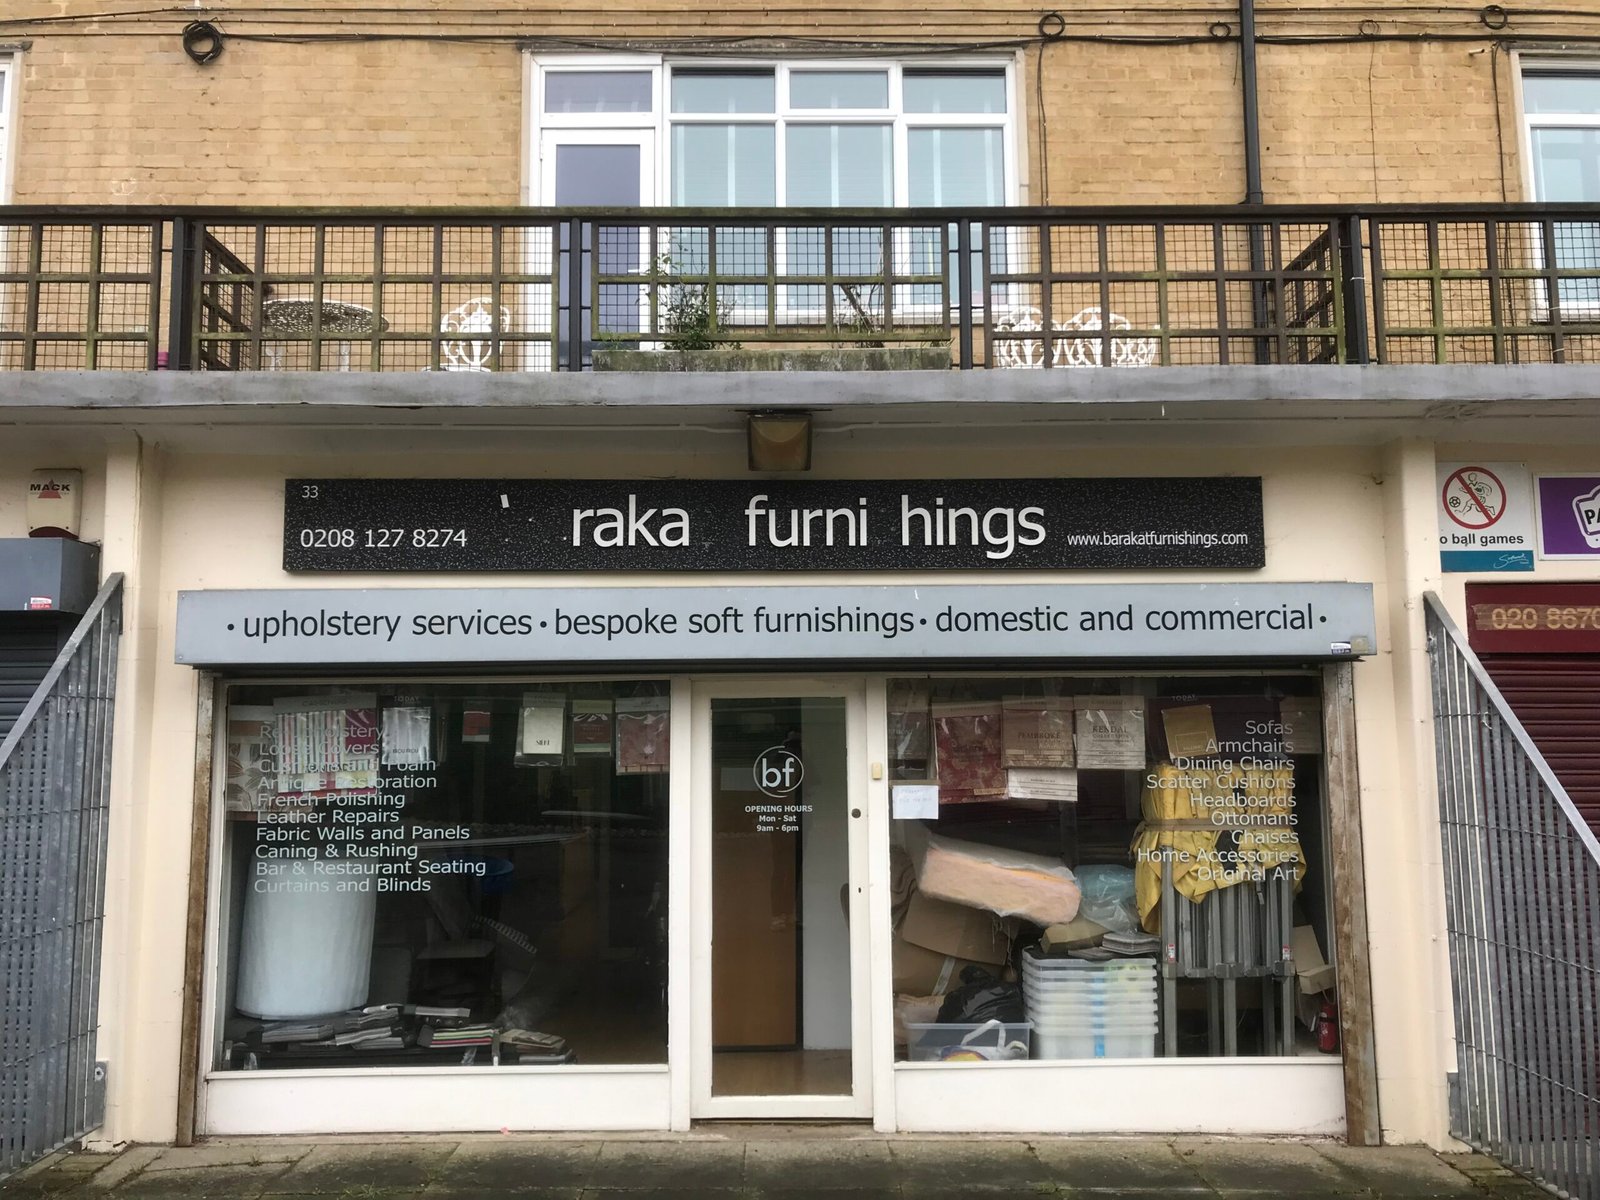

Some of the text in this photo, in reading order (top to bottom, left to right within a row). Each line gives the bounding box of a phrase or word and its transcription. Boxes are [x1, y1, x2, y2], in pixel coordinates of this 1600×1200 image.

[302, 485, 319, 498] 33
[572, 494, 1046, 558] raka furni hings
[300, 528, 468, 548] 0208 127 8274
[1067, 531, 1249, 548] www.barakatfurnishings.com
[1452, 534, 1475, 545] ball
[1481, 536, 1524, 546] games
[244, 603, 1313, 643] upholstery services bespoke soft furnishings domestic and commercial
[1492, 608, 1537, 629] 020
[1245, 720, 1293, 734] Sofas
[319, 741, 379, 756] Covers
[1205, 738, 1294, 752] Armchairs
[258, 759, 341, 772] Cushons
[348, 757, 379, 771] and
[1177, 756, 1295, 773] Dining Chairs
[762, 758, 795, 787] bf
[335, 774, 437, 789] Resoration
[1147, 775, 1296, 789] Scatter Cushions
[257, 792, 405, 809] French Polishing
[1190, 793, 1297, 807] Headboards
[257, 810, 399, 825] Leather Repairs
[1211, 811, 1298, 825] Ottomans
[256, 825, 470, 841] Fabric Walls and Panels
[1231, 830, 1299, 844] Chaises
[255, 843, 418, 861] Caning & Rushing
[1138, 848, 1299, 862] Home Accessories
[256, 860, 486, 876] Bar & Restaurant Seating
[1197, 866, 1300, 883] Original Art
[254, 877, 431, 892] Curtains and Blinds
